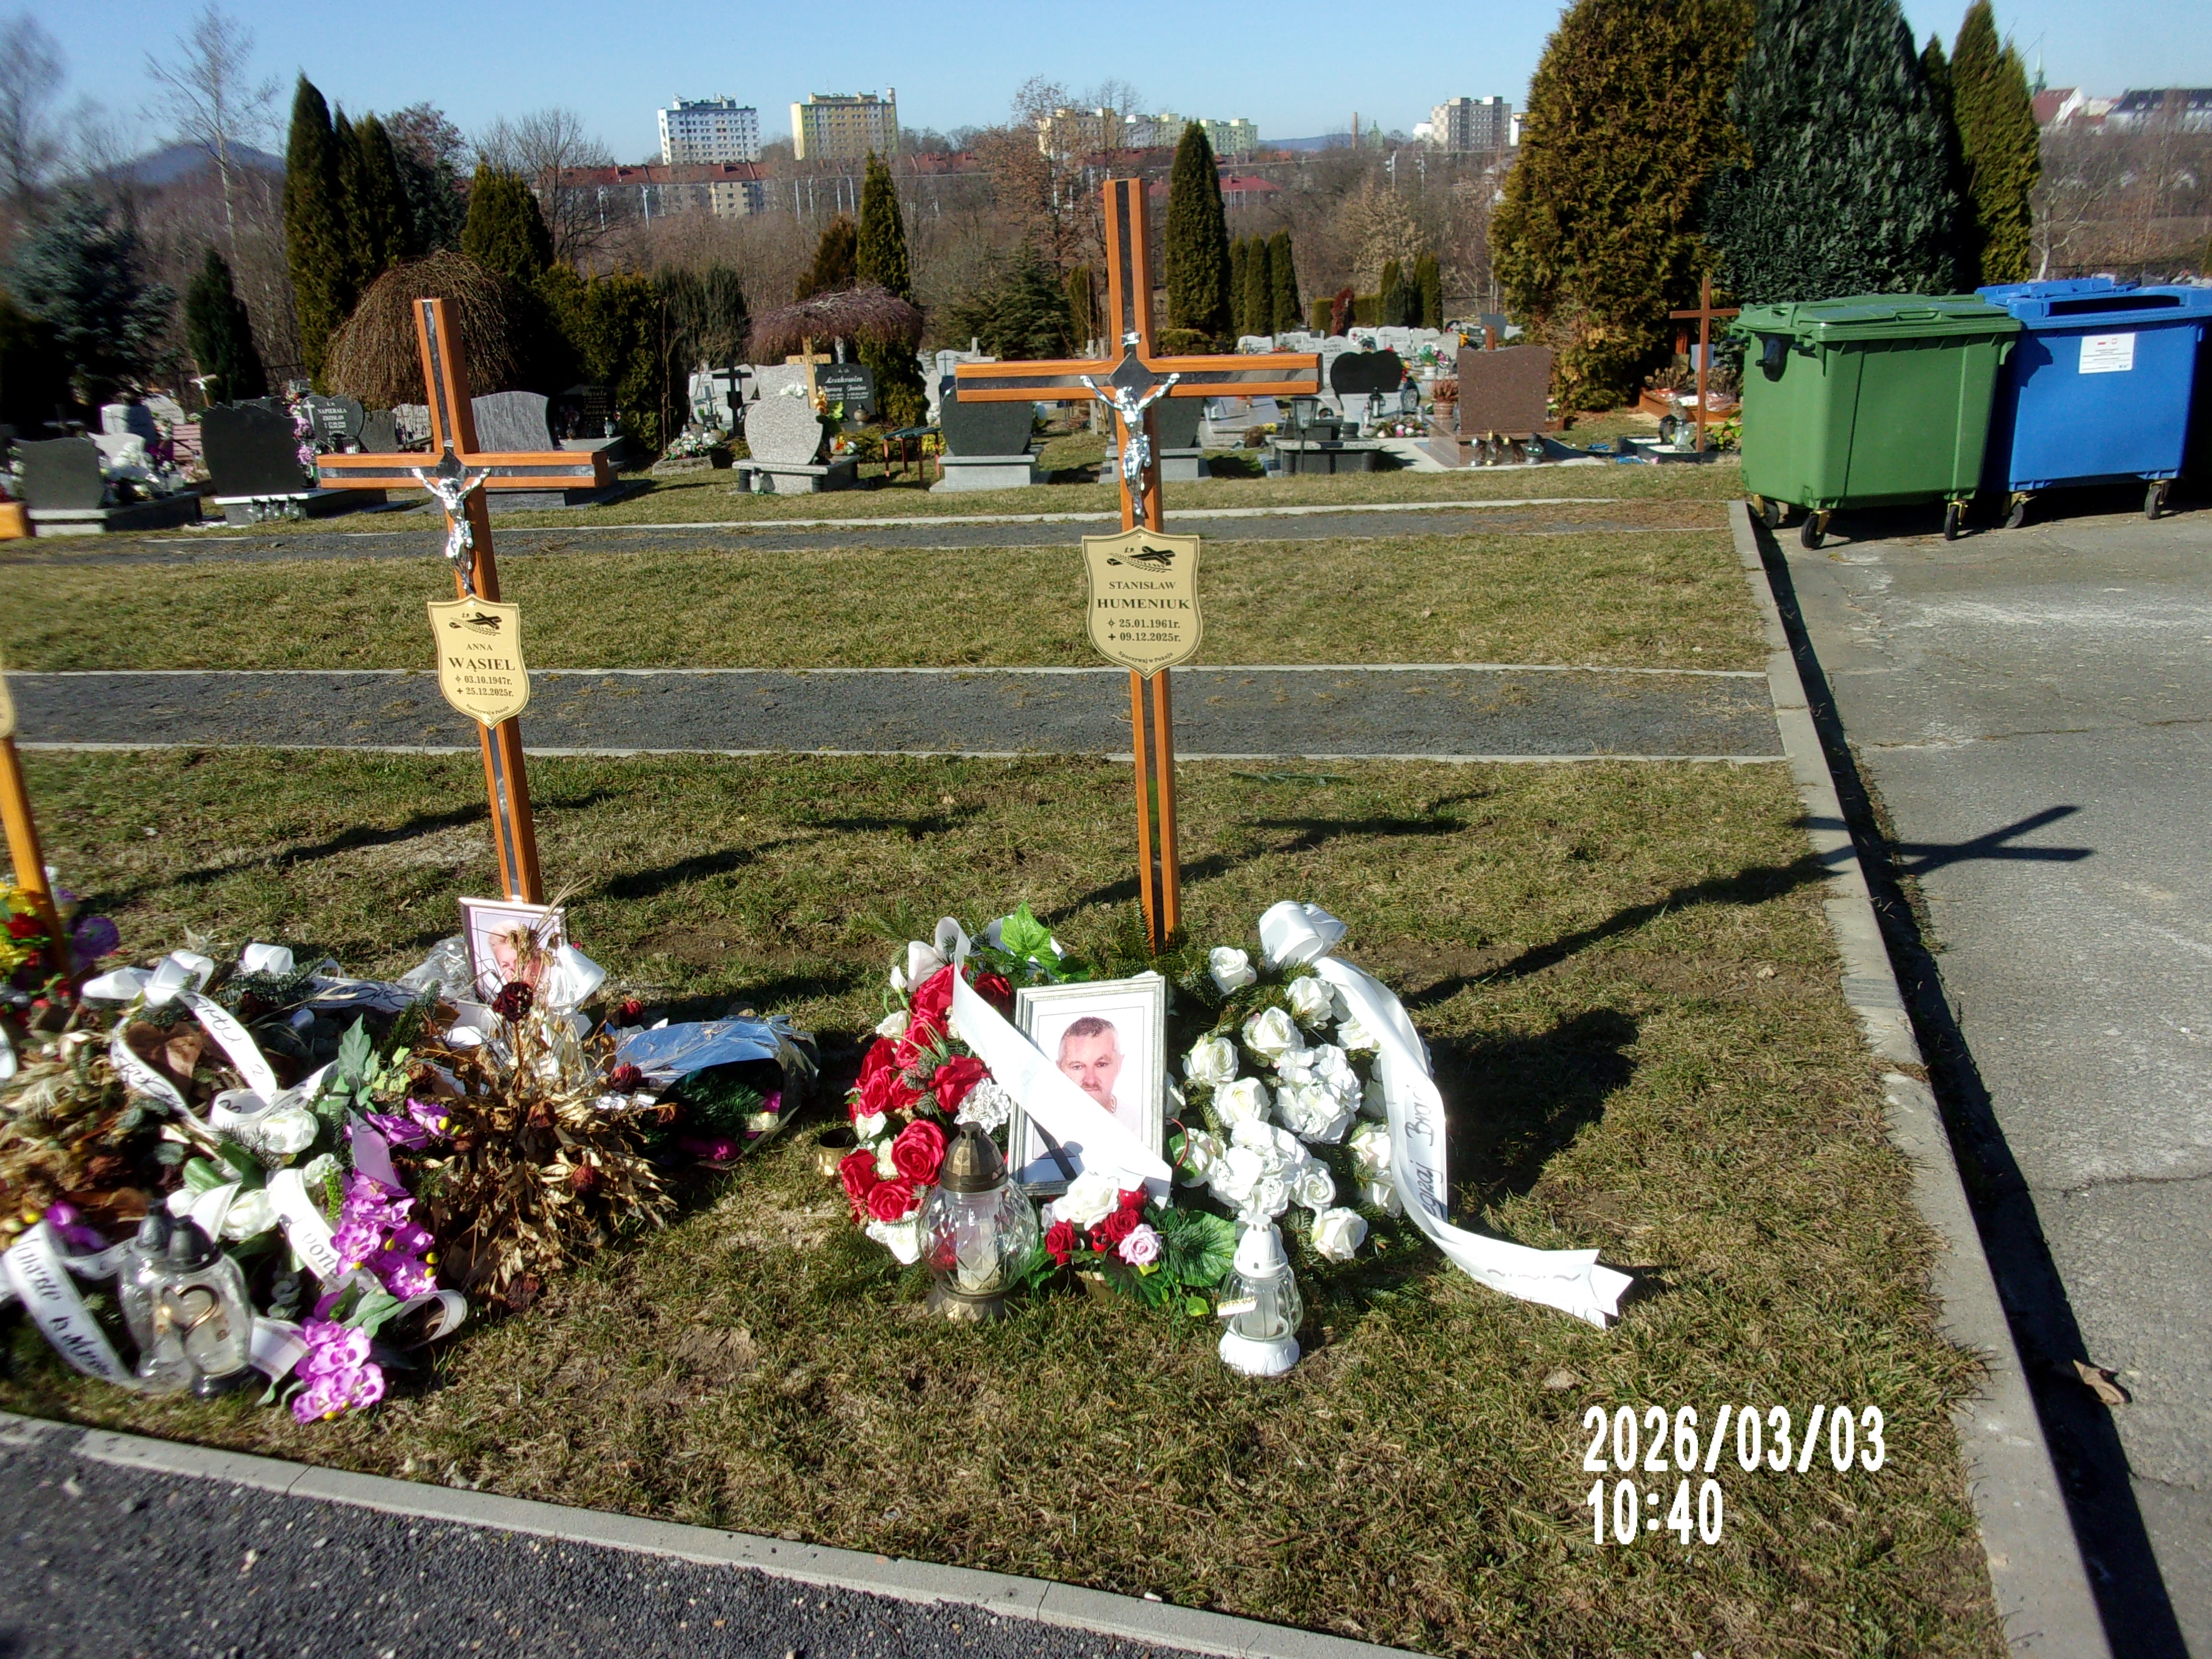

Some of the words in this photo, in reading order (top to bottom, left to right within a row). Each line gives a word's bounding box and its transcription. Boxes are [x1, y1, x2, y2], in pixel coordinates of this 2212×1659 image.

[1097, 599, 1191, 609] HUMENIUK
[1119, 619, 1180, 628] 25.01.1961r.
[1120, 633, 1181, 642] 09.12.2025r.
[448, 657, 516, 672] WĄSIEL
[464, 675, 513, 685] 03.10.1947r.
[466, 687, 514, 697] 25.12.2025r.
